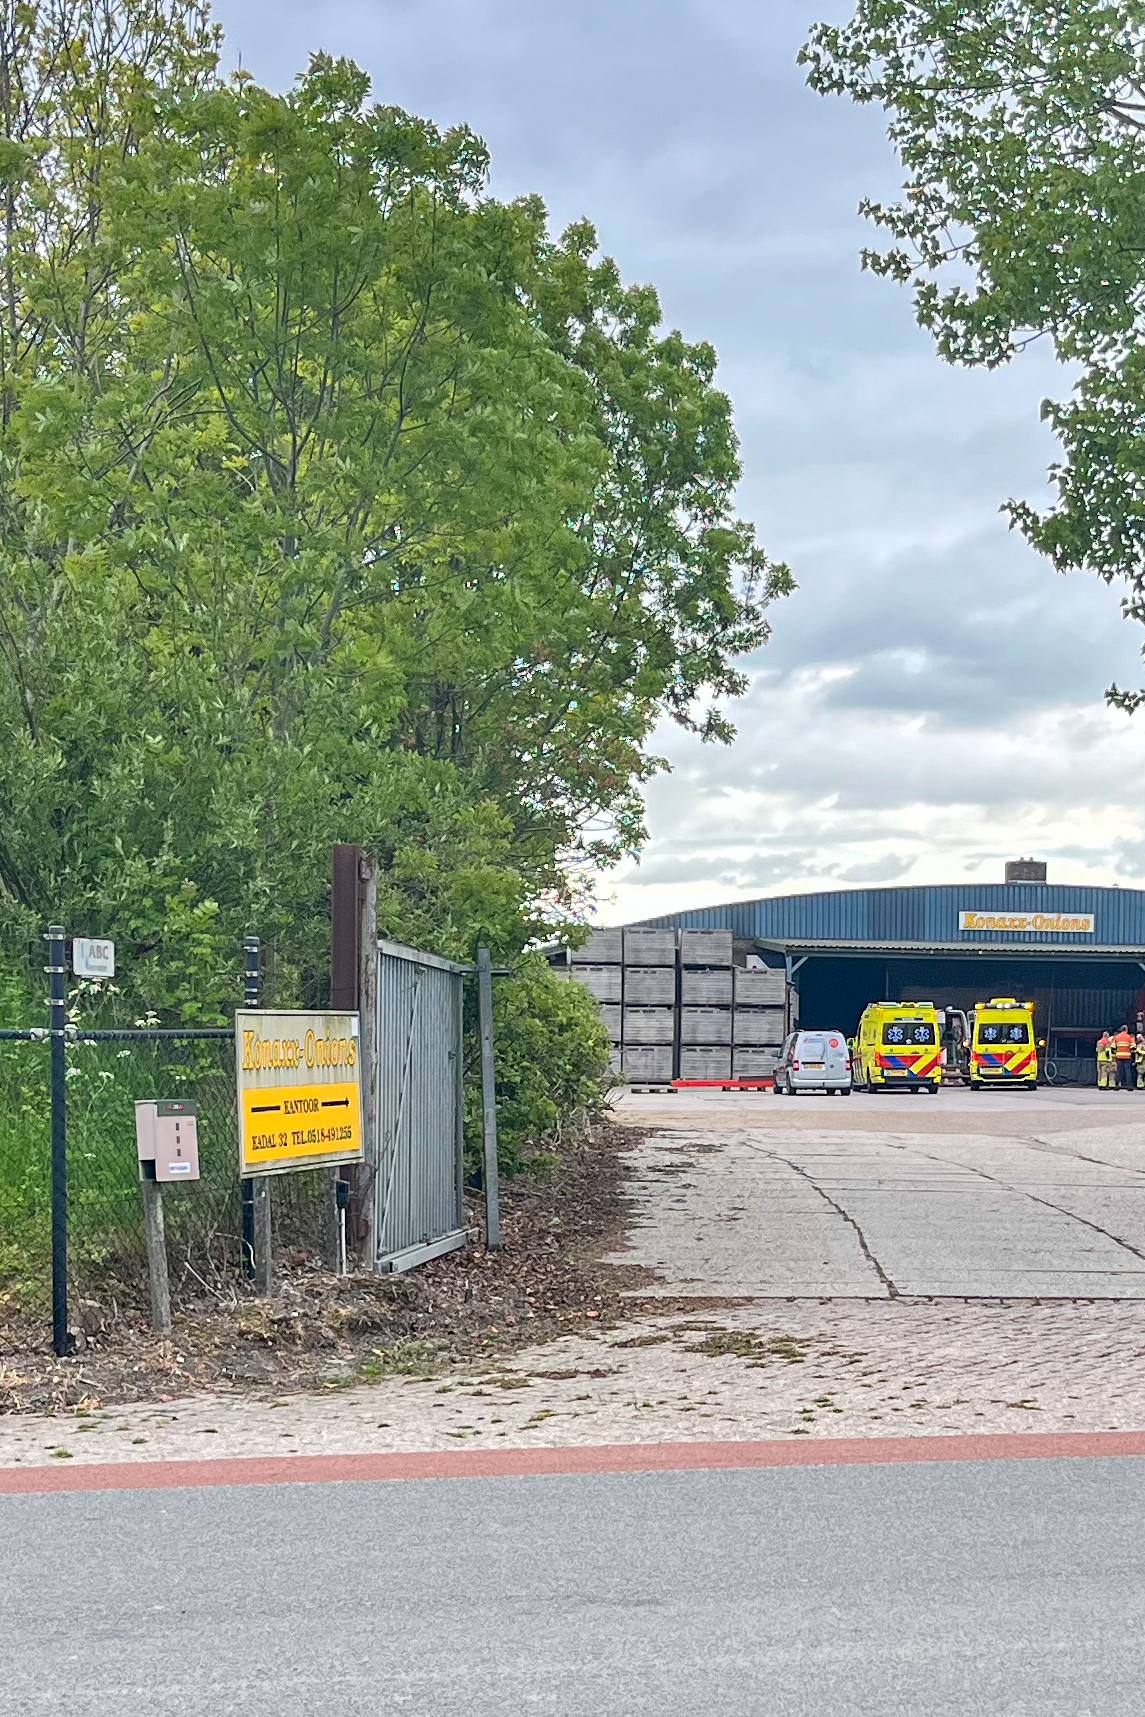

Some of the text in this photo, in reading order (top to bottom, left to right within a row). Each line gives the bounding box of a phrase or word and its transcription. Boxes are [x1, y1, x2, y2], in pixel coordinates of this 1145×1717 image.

[963, 912, 1091, 931] Konaxx-Onions
[88, 944, 109, 960] ABC
[242, 1026, 356, 1070] Konaxx-Onions
[284, 1098, 319, 1114] KANTOOR
[278, 1132, 288, 1147] 32
